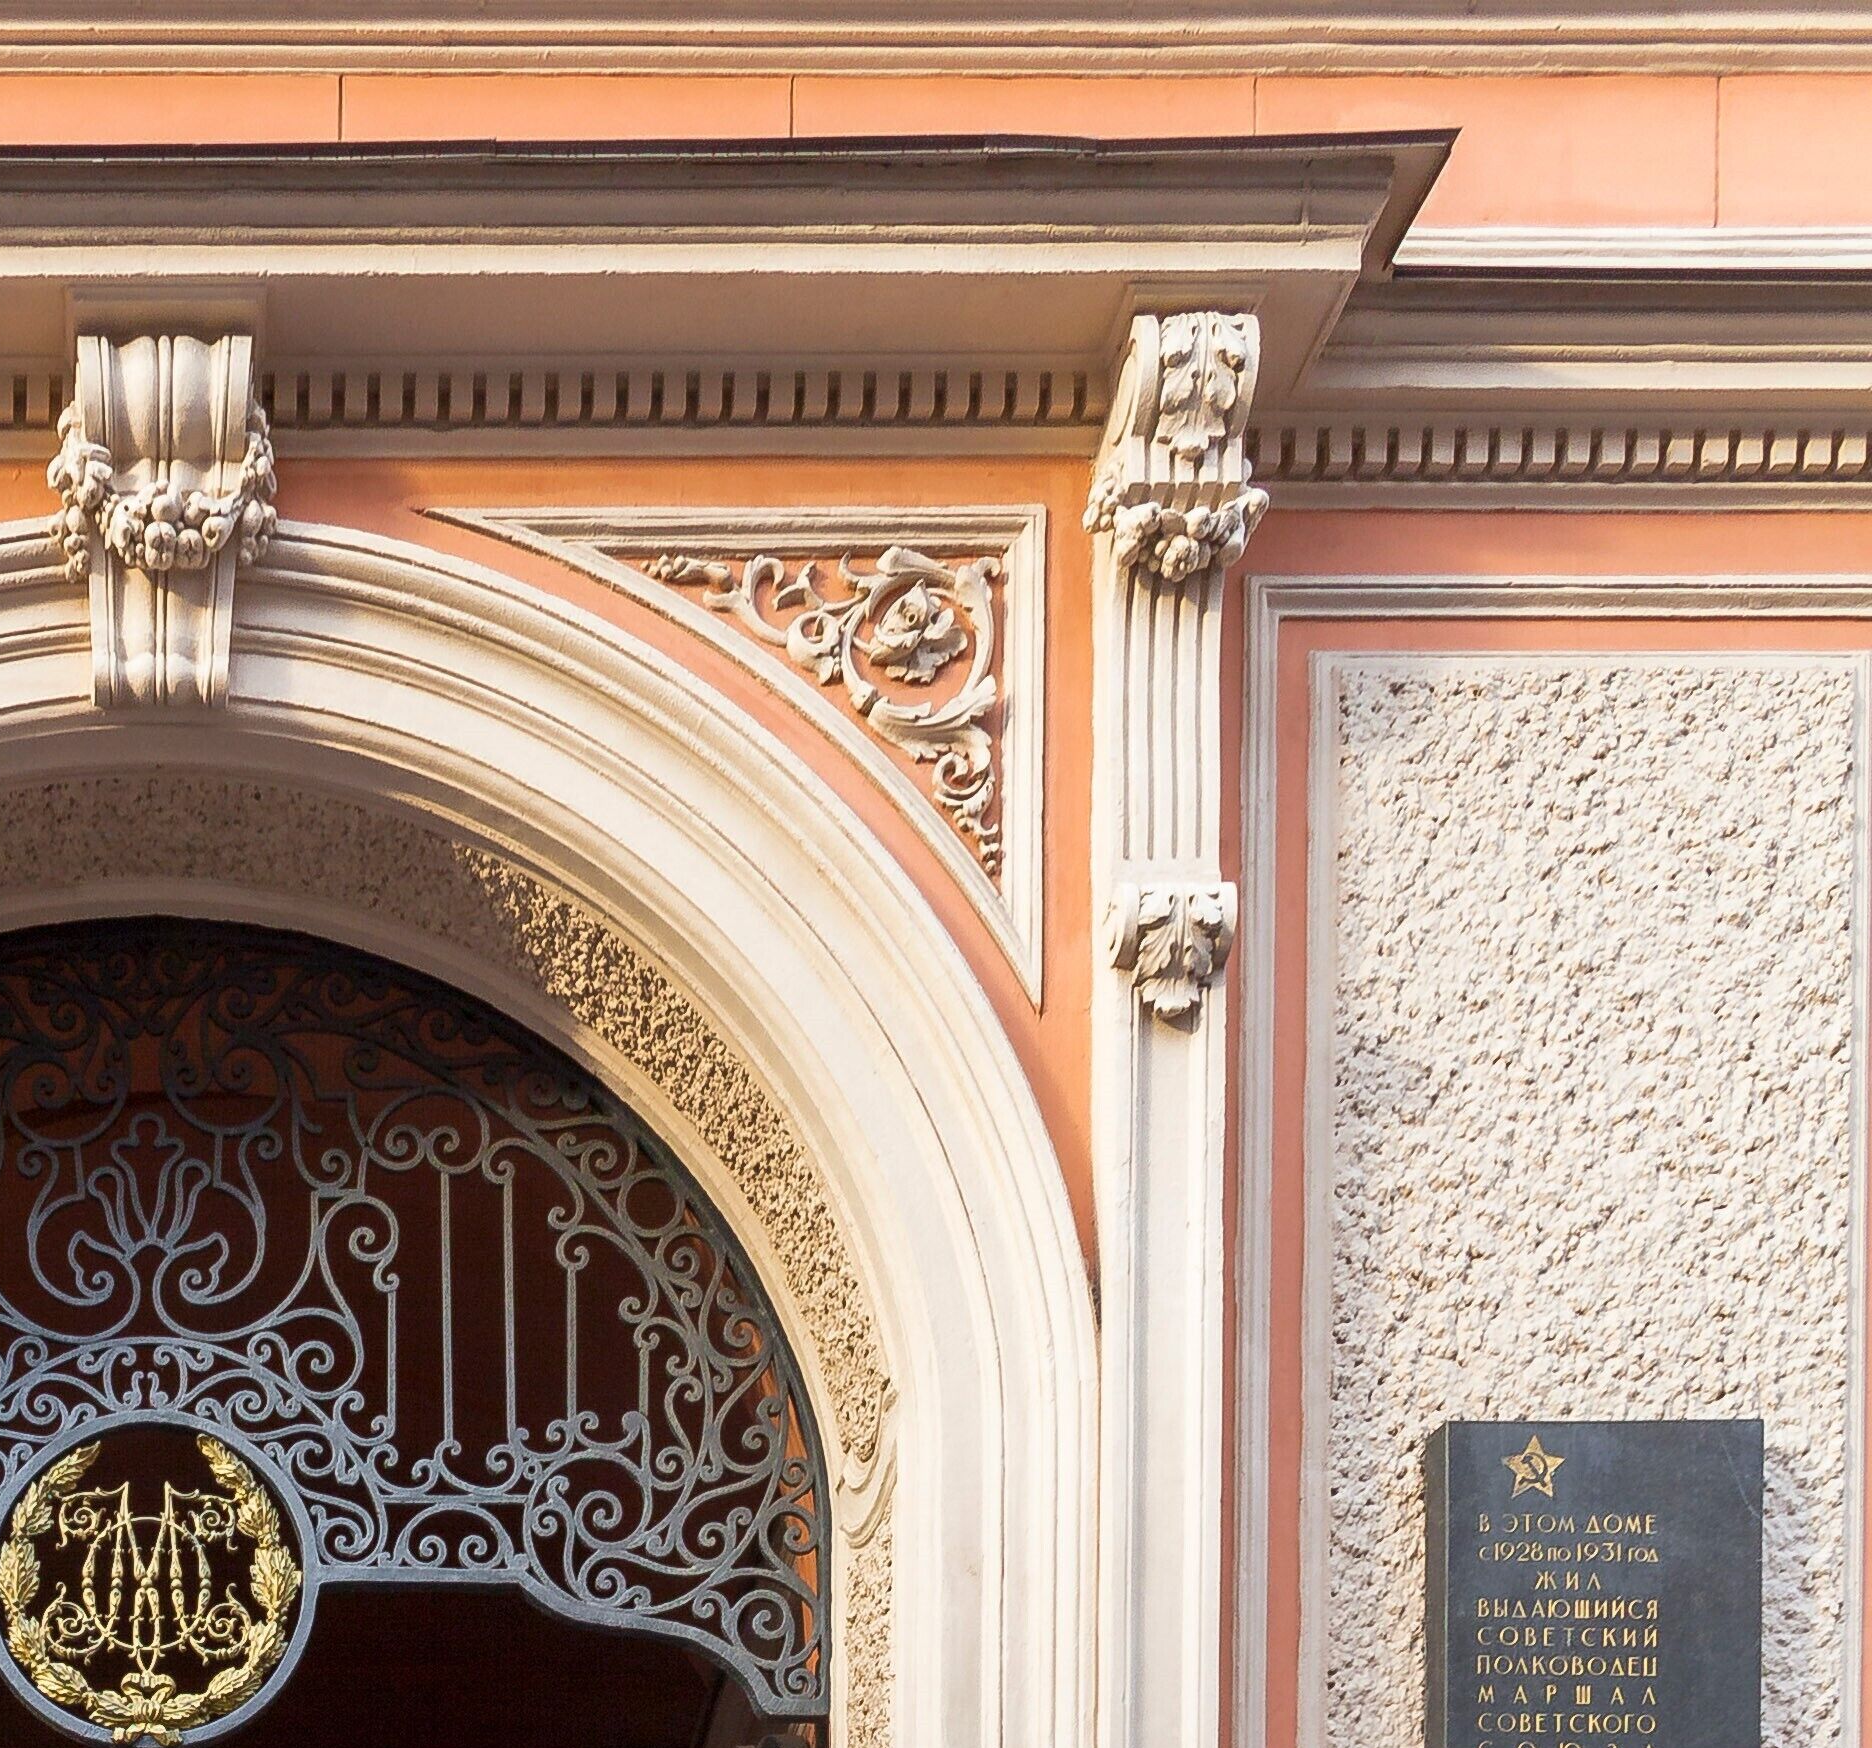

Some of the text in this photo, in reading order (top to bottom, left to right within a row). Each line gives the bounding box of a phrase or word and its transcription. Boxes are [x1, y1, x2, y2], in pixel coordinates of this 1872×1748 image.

[1478, 1513, 1658, 1535] В ЭТОМ ДОМЕ
[1493, 1541, 1544, 1562] 1928
[1547, 1547, 1572, 1562] по
[1576, 1541, 1622, 1562] 1931
[1628, 1547, 1659, 1563] год
[1534, 1570, 1602, 1591] ЖИЛ
[1477, 1624, 1658, 1648] СОВЕТСКИЙ
[1477, 1655, 1658, 1677] ПОЛКОВОДЕЦ
[1478, 1684, 1657, 1705] МАРШАЛ
[1478, 1712, 1657, 1735] СОВЕТСКОГО
